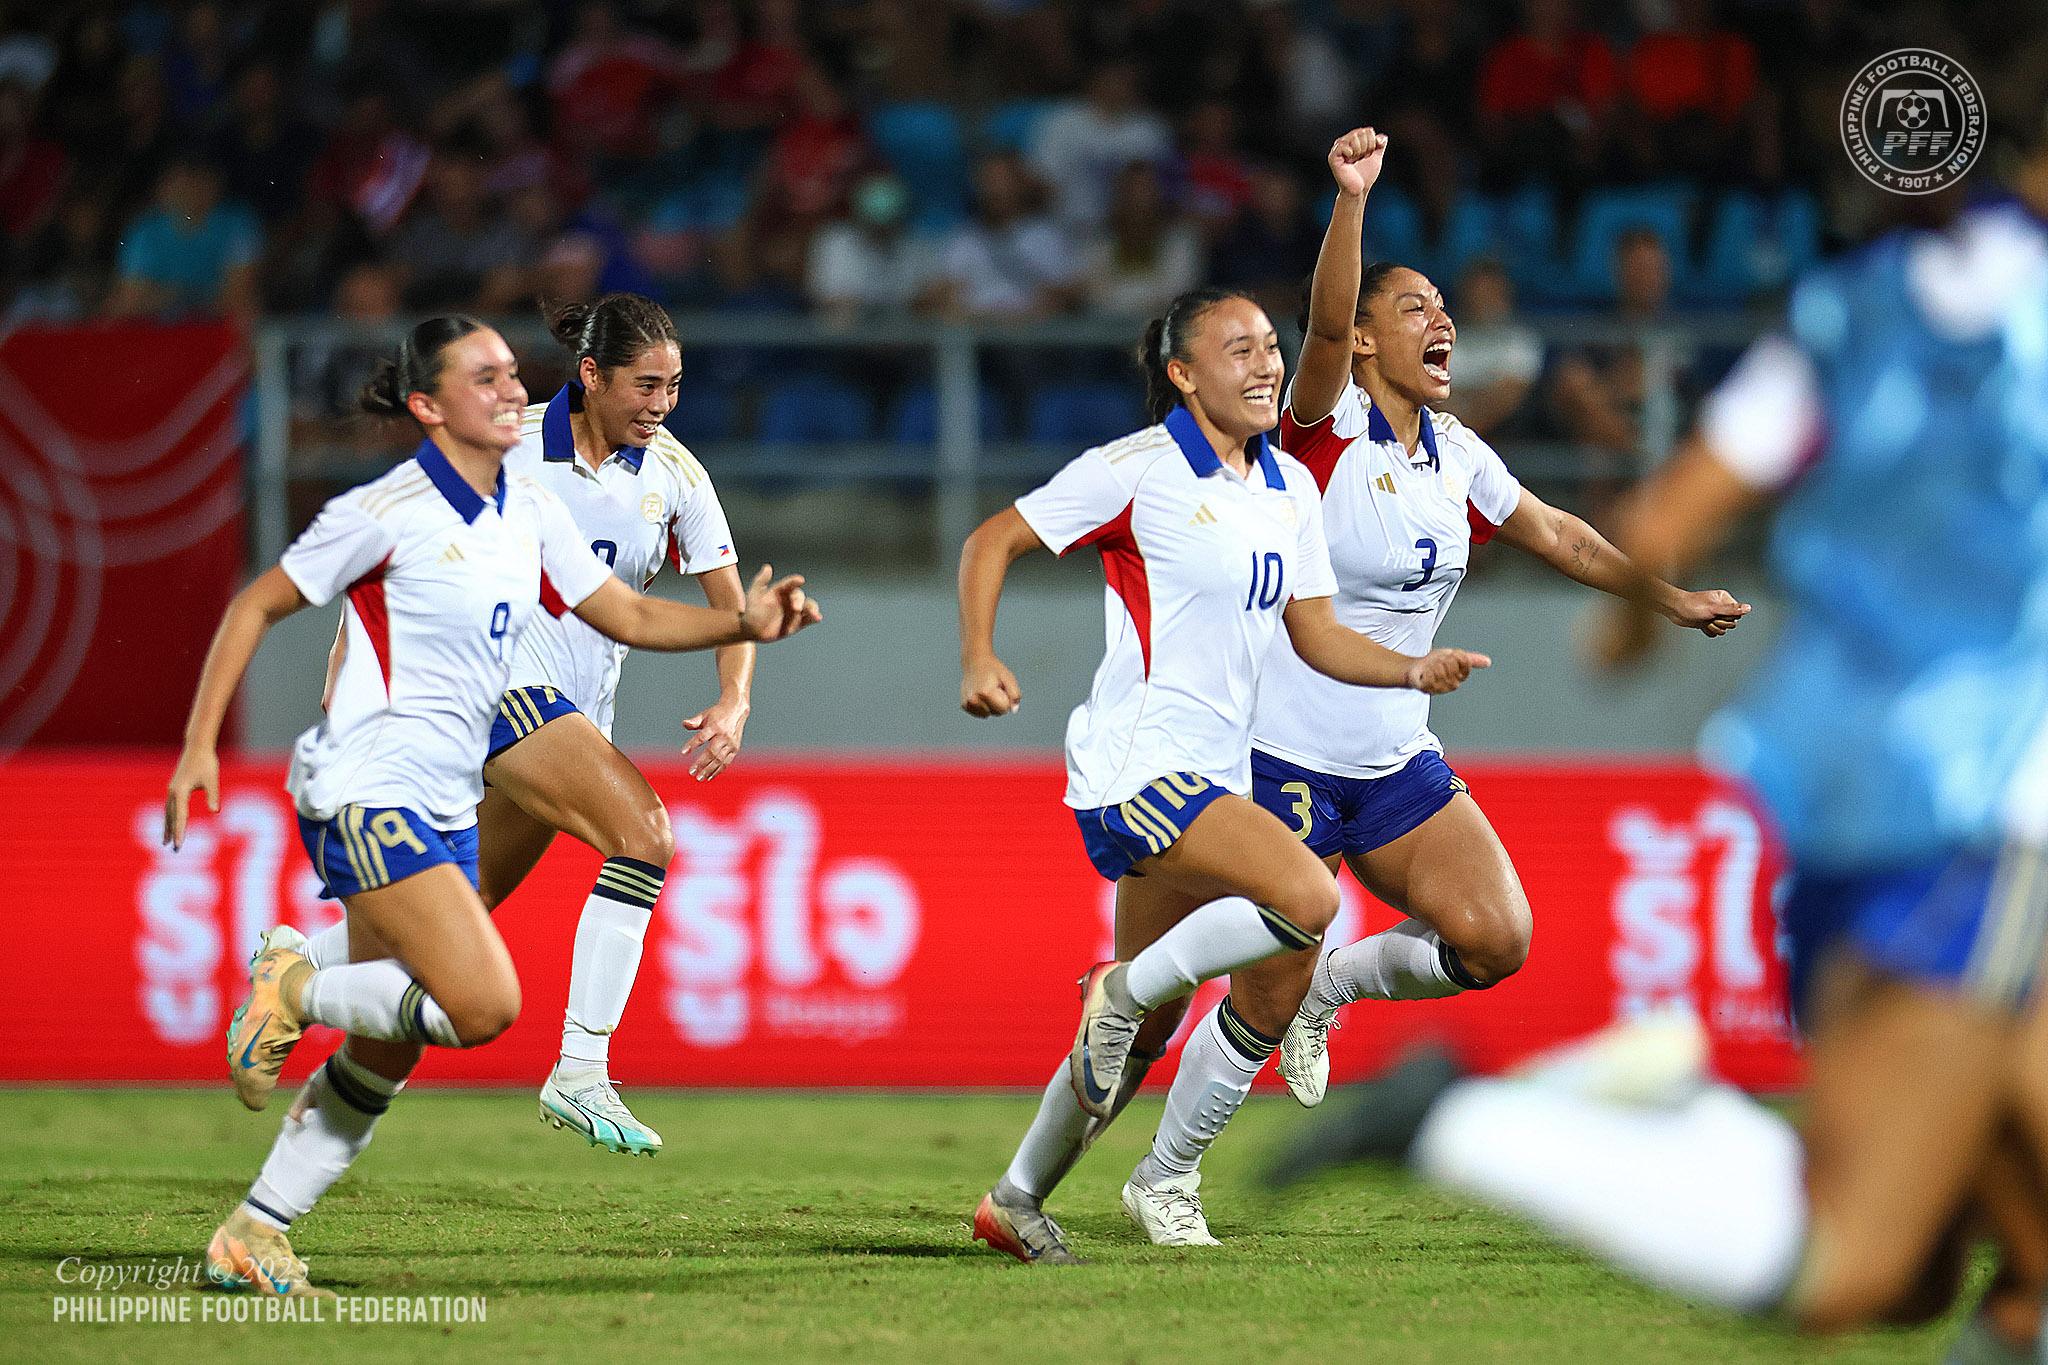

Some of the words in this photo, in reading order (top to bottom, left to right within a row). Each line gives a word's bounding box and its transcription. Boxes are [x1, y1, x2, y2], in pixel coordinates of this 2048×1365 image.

[1245, 550, 1282, 611] 10
[1401, 538, 1437, 592] 3
[371, 809, 429, 855] 9
[1280, 782, 1313, 841] 3
